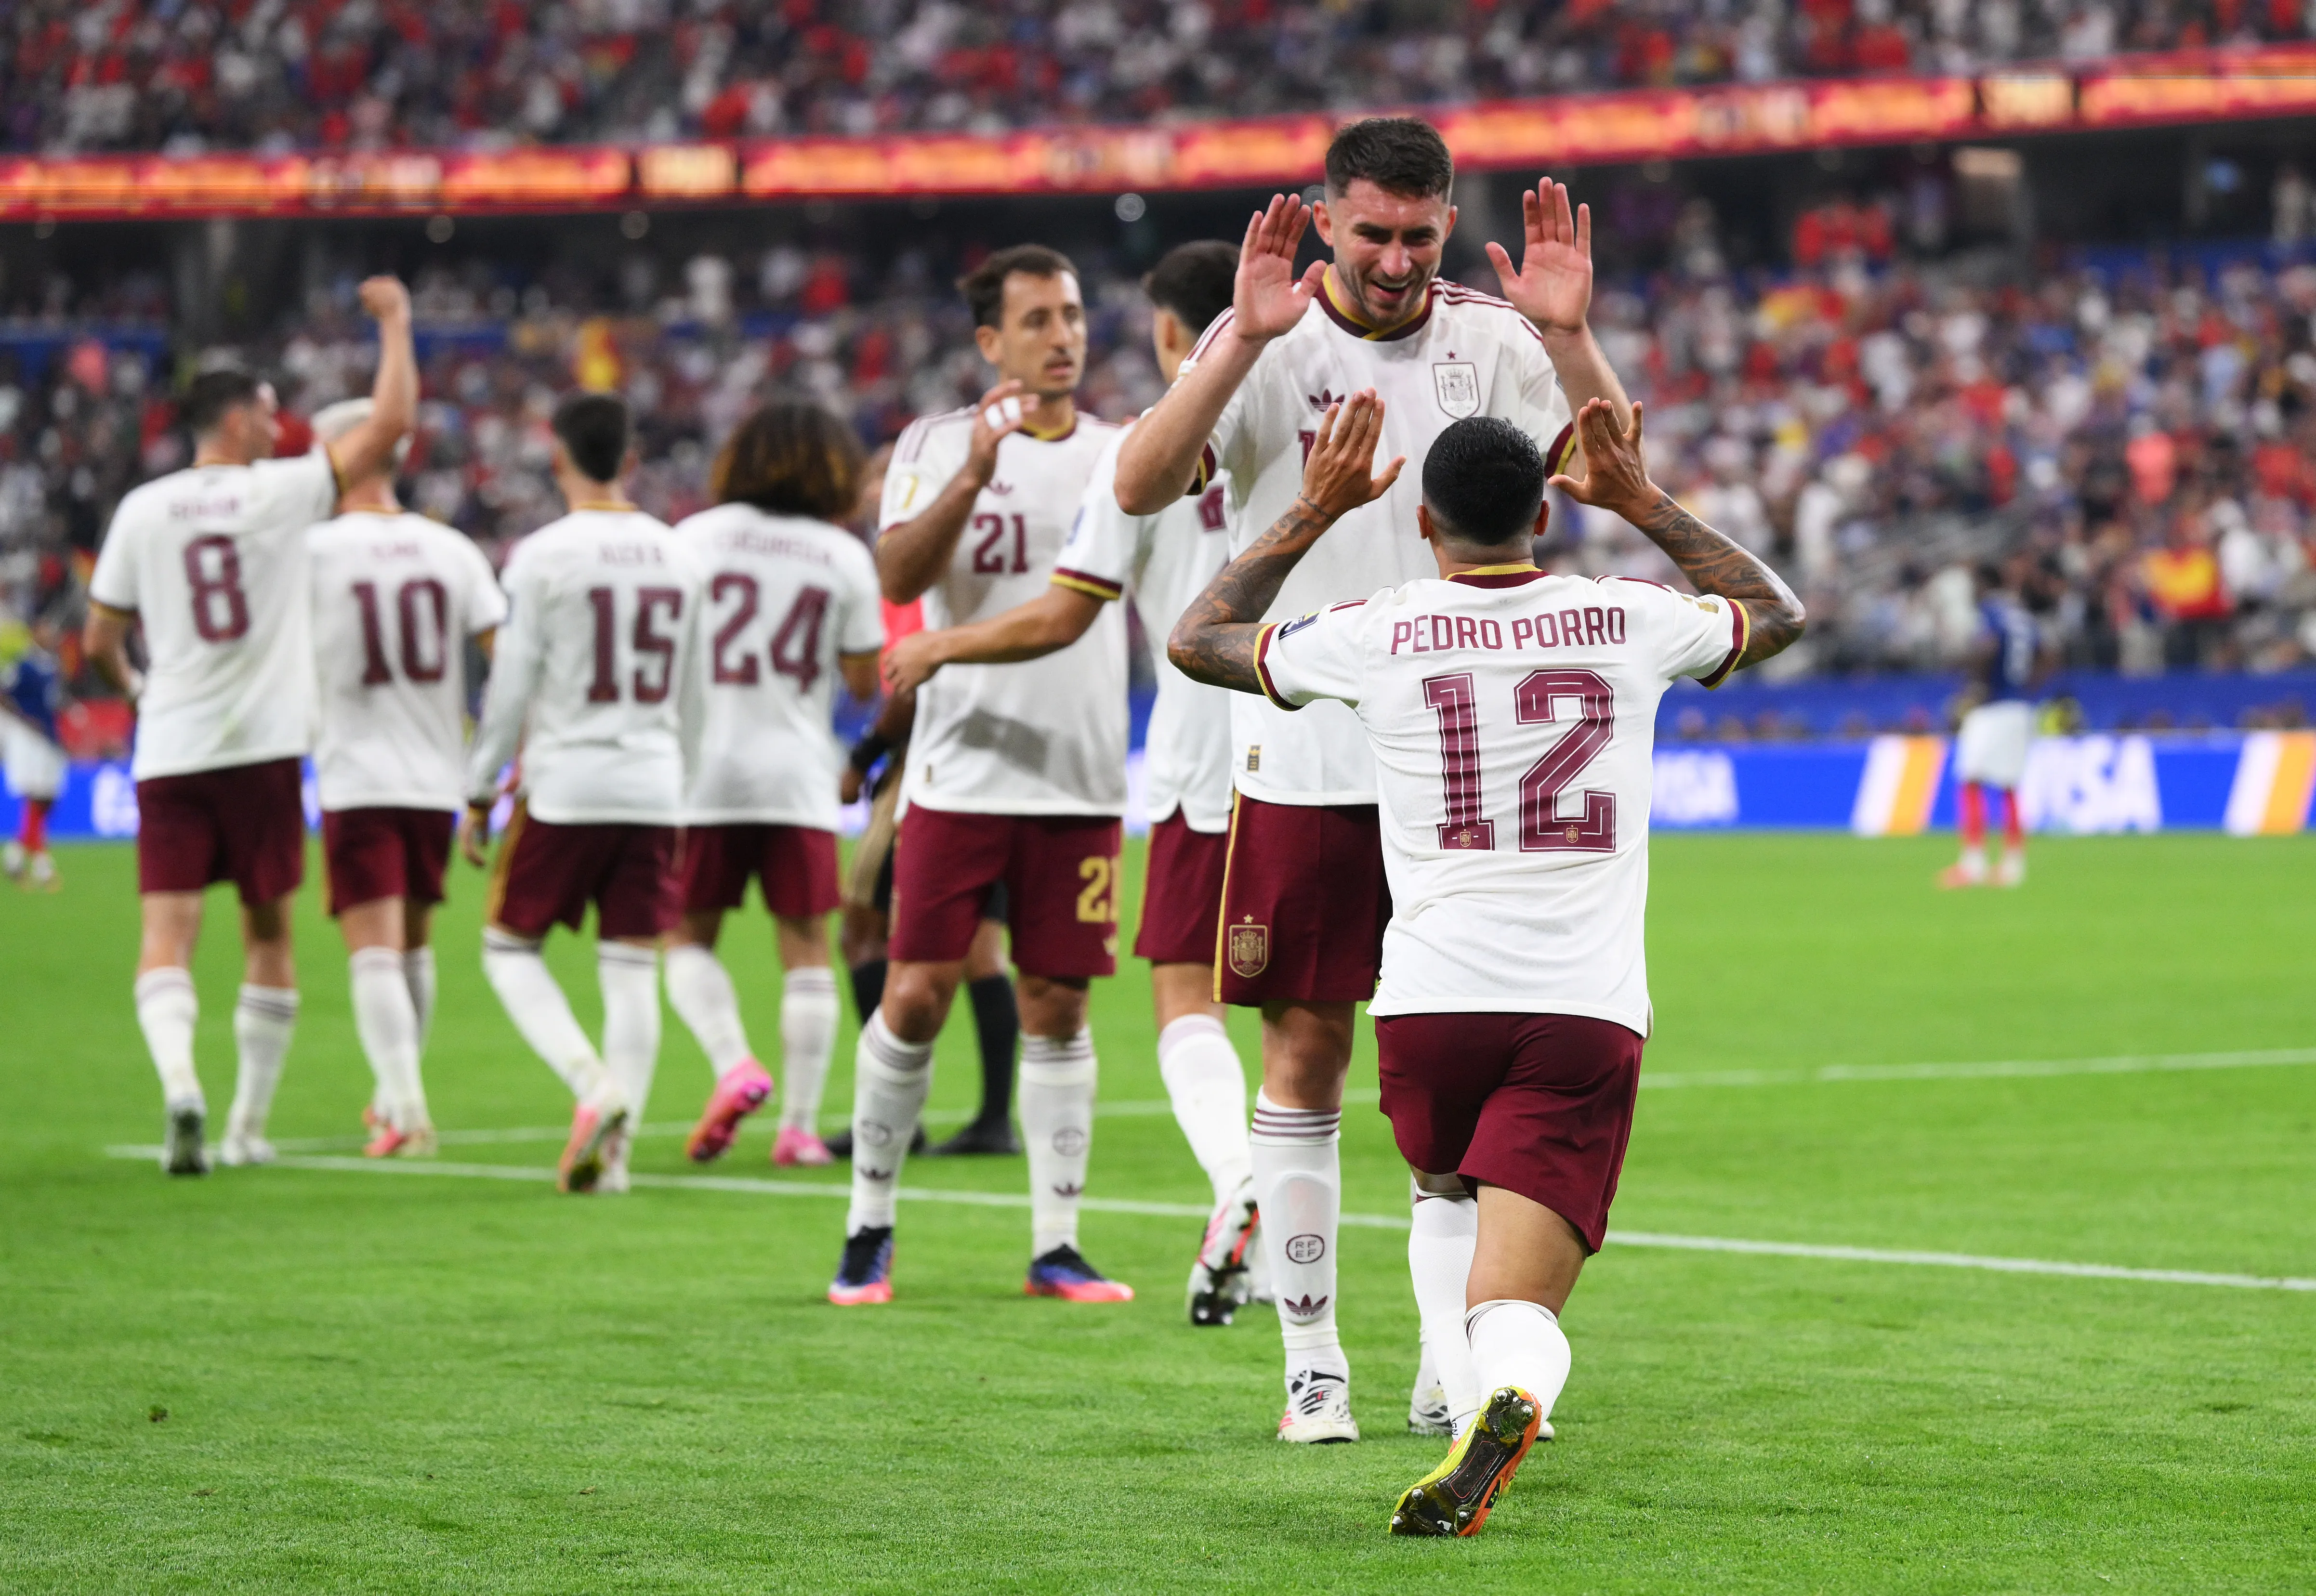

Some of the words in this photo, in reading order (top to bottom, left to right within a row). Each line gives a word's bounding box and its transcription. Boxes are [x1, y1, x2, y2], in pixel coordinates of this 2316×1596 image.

[184, 535, 250, 644] 8
[973, 513, 1027, 574] 21
[353, 579, 447, 686] 10
[589, 586, 683, 703] 15
[711, 572, 829, 693] 24
[1391, 615, 1502, 654] PEDRO
[1512, 607, 1626, 650] PORRO
[1422, 669, 1616, 853] 12
